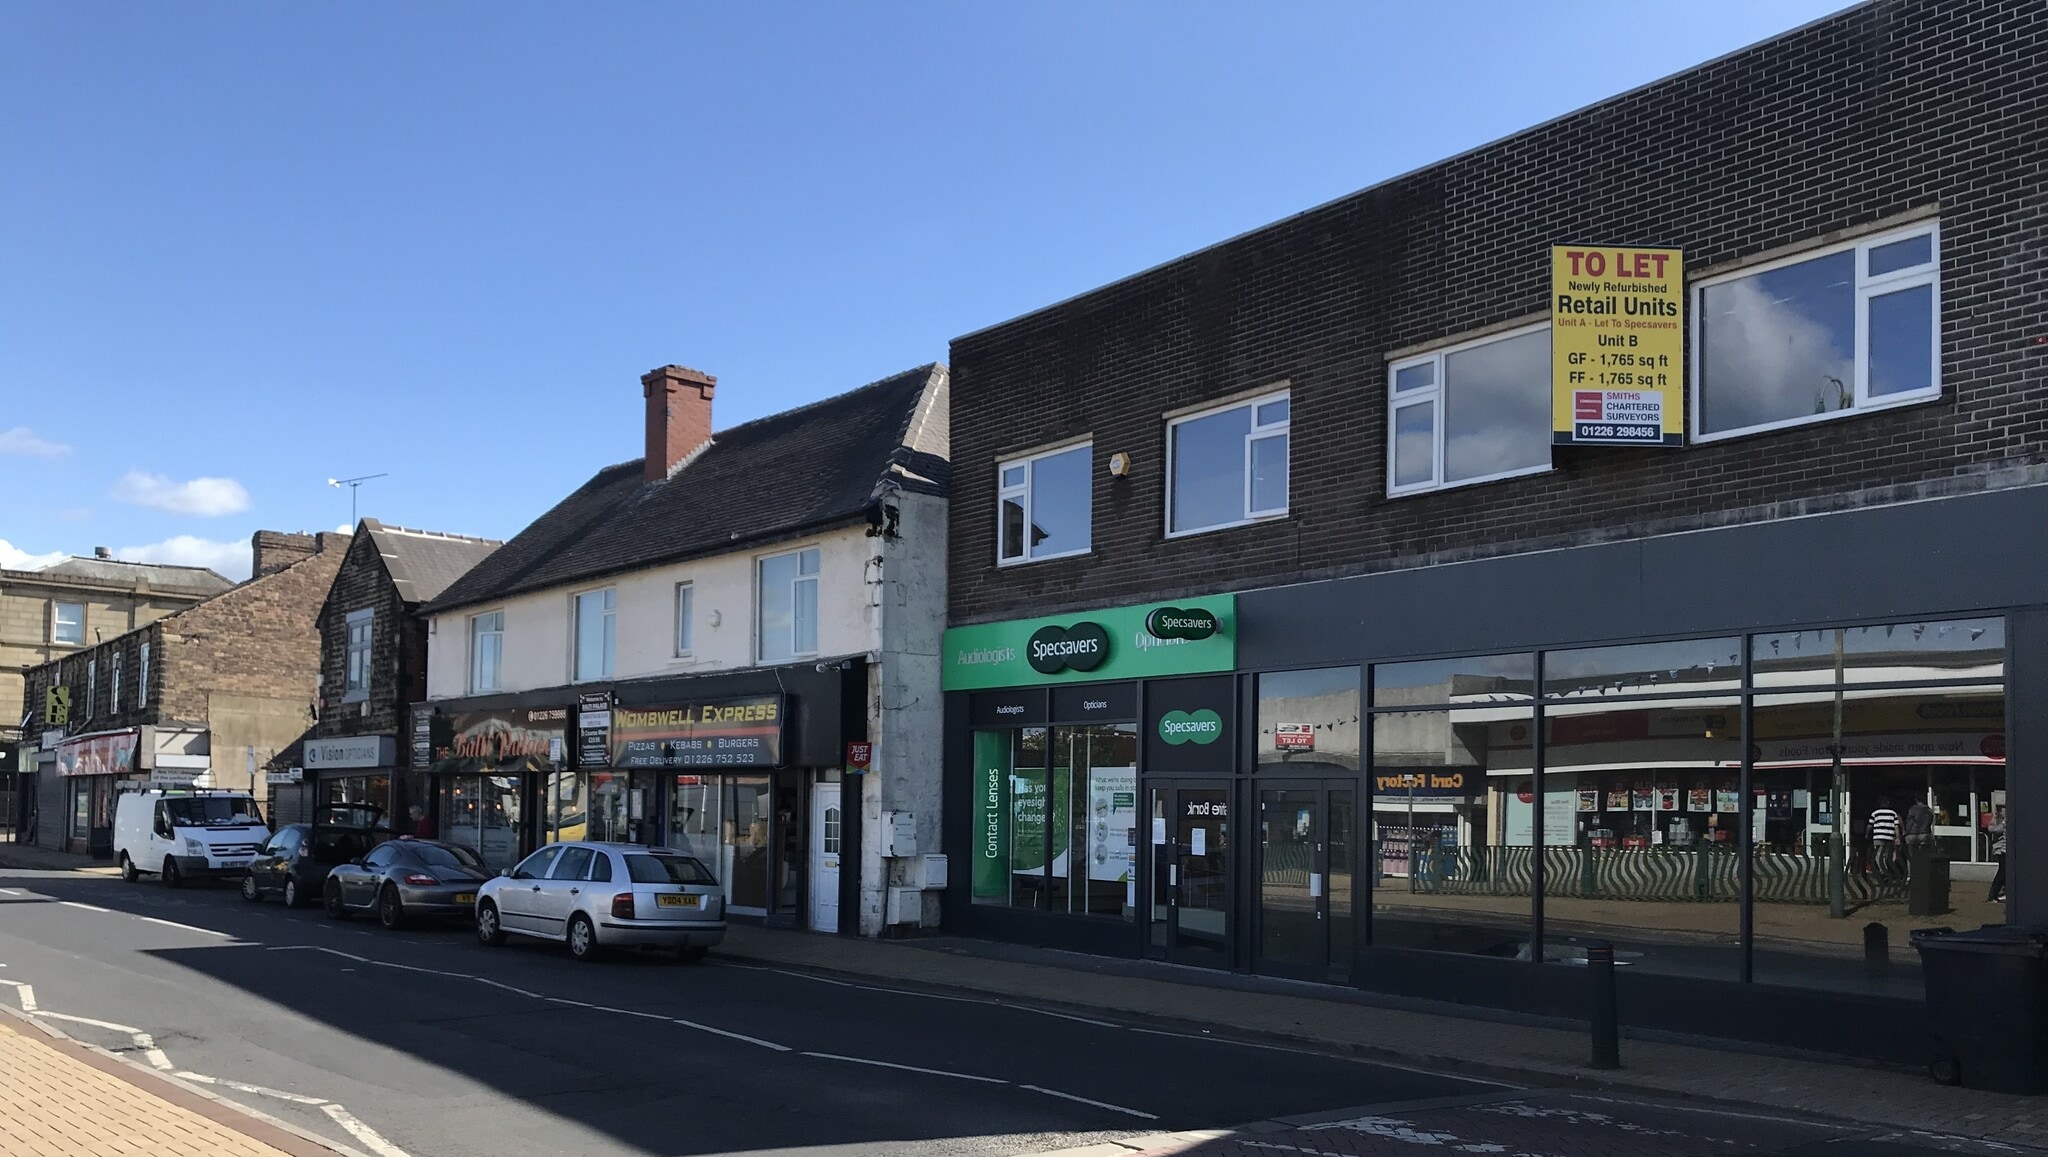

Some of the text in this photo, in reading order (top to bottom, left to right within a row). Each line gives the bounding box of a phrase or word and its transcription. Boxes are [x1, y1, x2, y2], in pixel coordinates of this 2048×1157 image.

[1566, 251, 1670, 279] TO LET
[1568, 281, 1667, 294] Newly Refurbished
[1558, 295, 1677, 317] Retail Units
[1558, 318, 1577, 327] Unit
[1579, 319, 1586, 327] A
[1594, 319, 1609, 328] Let
[1611, 319, 1622, 328] To
[1624, 320, 1678, 331] Specsavers
[1598, 334, 1638, 347] Unit B
[1568, 353, 1587, 365] GF
[1600, 354, 1634, 368] 1,765
[1638, 357, 1655, 369] sq
[1658, 355, 1668, 367] ft
[1569, 371, 1586, 384] FF
[1599, 373, 1633, 387] 1,765
[1637, 376, 1654, 388] sq
[1657, 373, 1667, 386] ft
[1606, 392, 1640, 401] SMITHS
[1606, 402, 1660, 411] CHARTERED
[1606, 412, 1660, 422] SURVEYORS
[1581, 426, 1655, 438] 01226 298456
[1161, 615, 1212, 630] Specsavers
[1033, 637, 1098, 660] Specsavers
[957, 646, 1016, 665] Audiologists
[996, 704, 1025, 715] Audiologists
[1083, 699, 1107, 711] Opticians
[1164, 719, 1216, 735] Specsavers
[320, 745, 344, 761] Vision
[435, 746, 449, 760] THE
[851, 745, 868, 754] JUST
[684, 754, 712, 764] 01226
[715, 754, 733, 763] 752
[736, 753, 754, 763] 523
[854, 753, 868, 762] EAT
[1120, 776, 1133, 784] doing
[1018, 783, 1033, 793] Has
[1017, 796, 1046, 809] eyesig
[985, 768, 999, 859] Contact Lenses
[1017, 811, 1056, 825] change?
[683, 896, 697, 905] XAE
